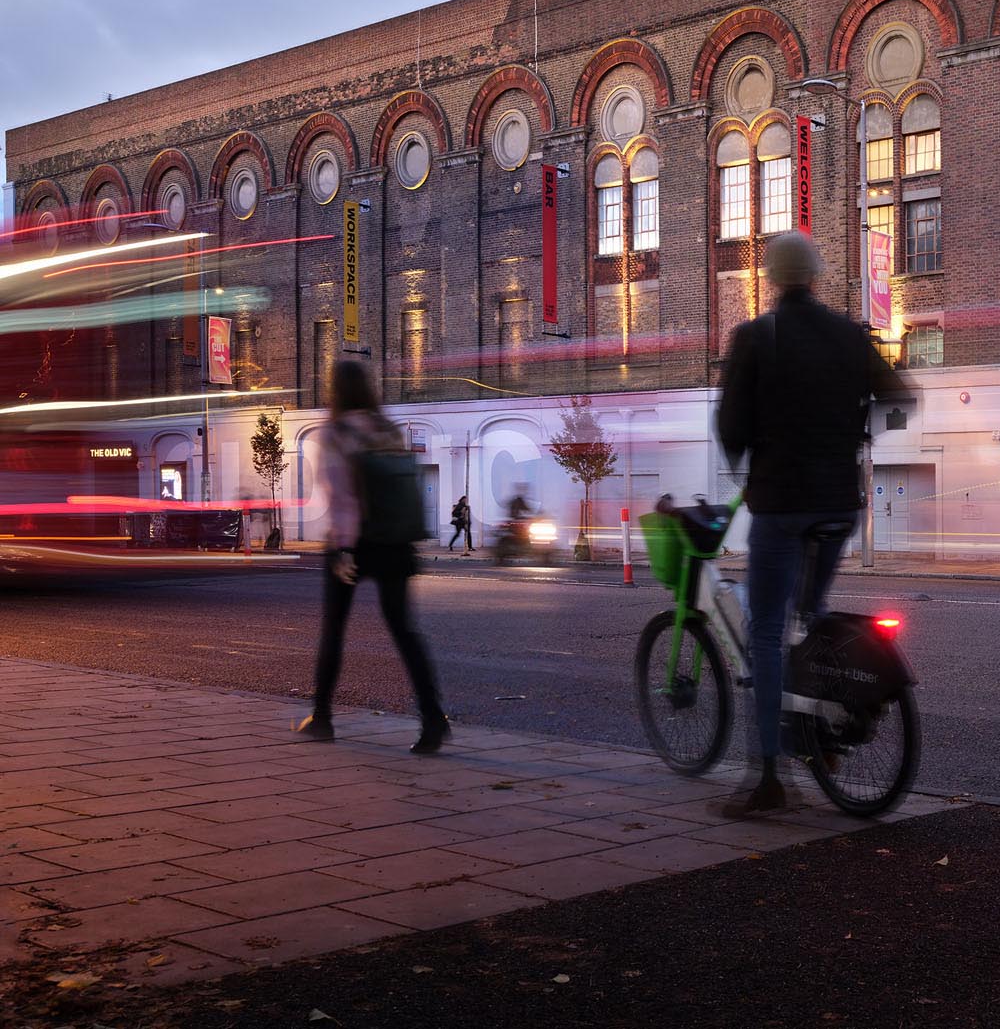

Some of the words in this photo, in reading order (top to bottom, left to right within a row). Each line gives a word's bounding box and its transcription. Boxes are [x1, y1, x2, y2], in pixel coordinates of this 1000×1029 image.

[545, 171, 553, 209] BAR
[800, 125, 809, 227] WELCOME
[346, 208, 356, 305] WORKSPACE
[90, 449, 104, 458] THE
[104, 448, 119, 457] OLD
[119, 447, 132, 457] VIC
[852, 669, 879, 684] Uber
